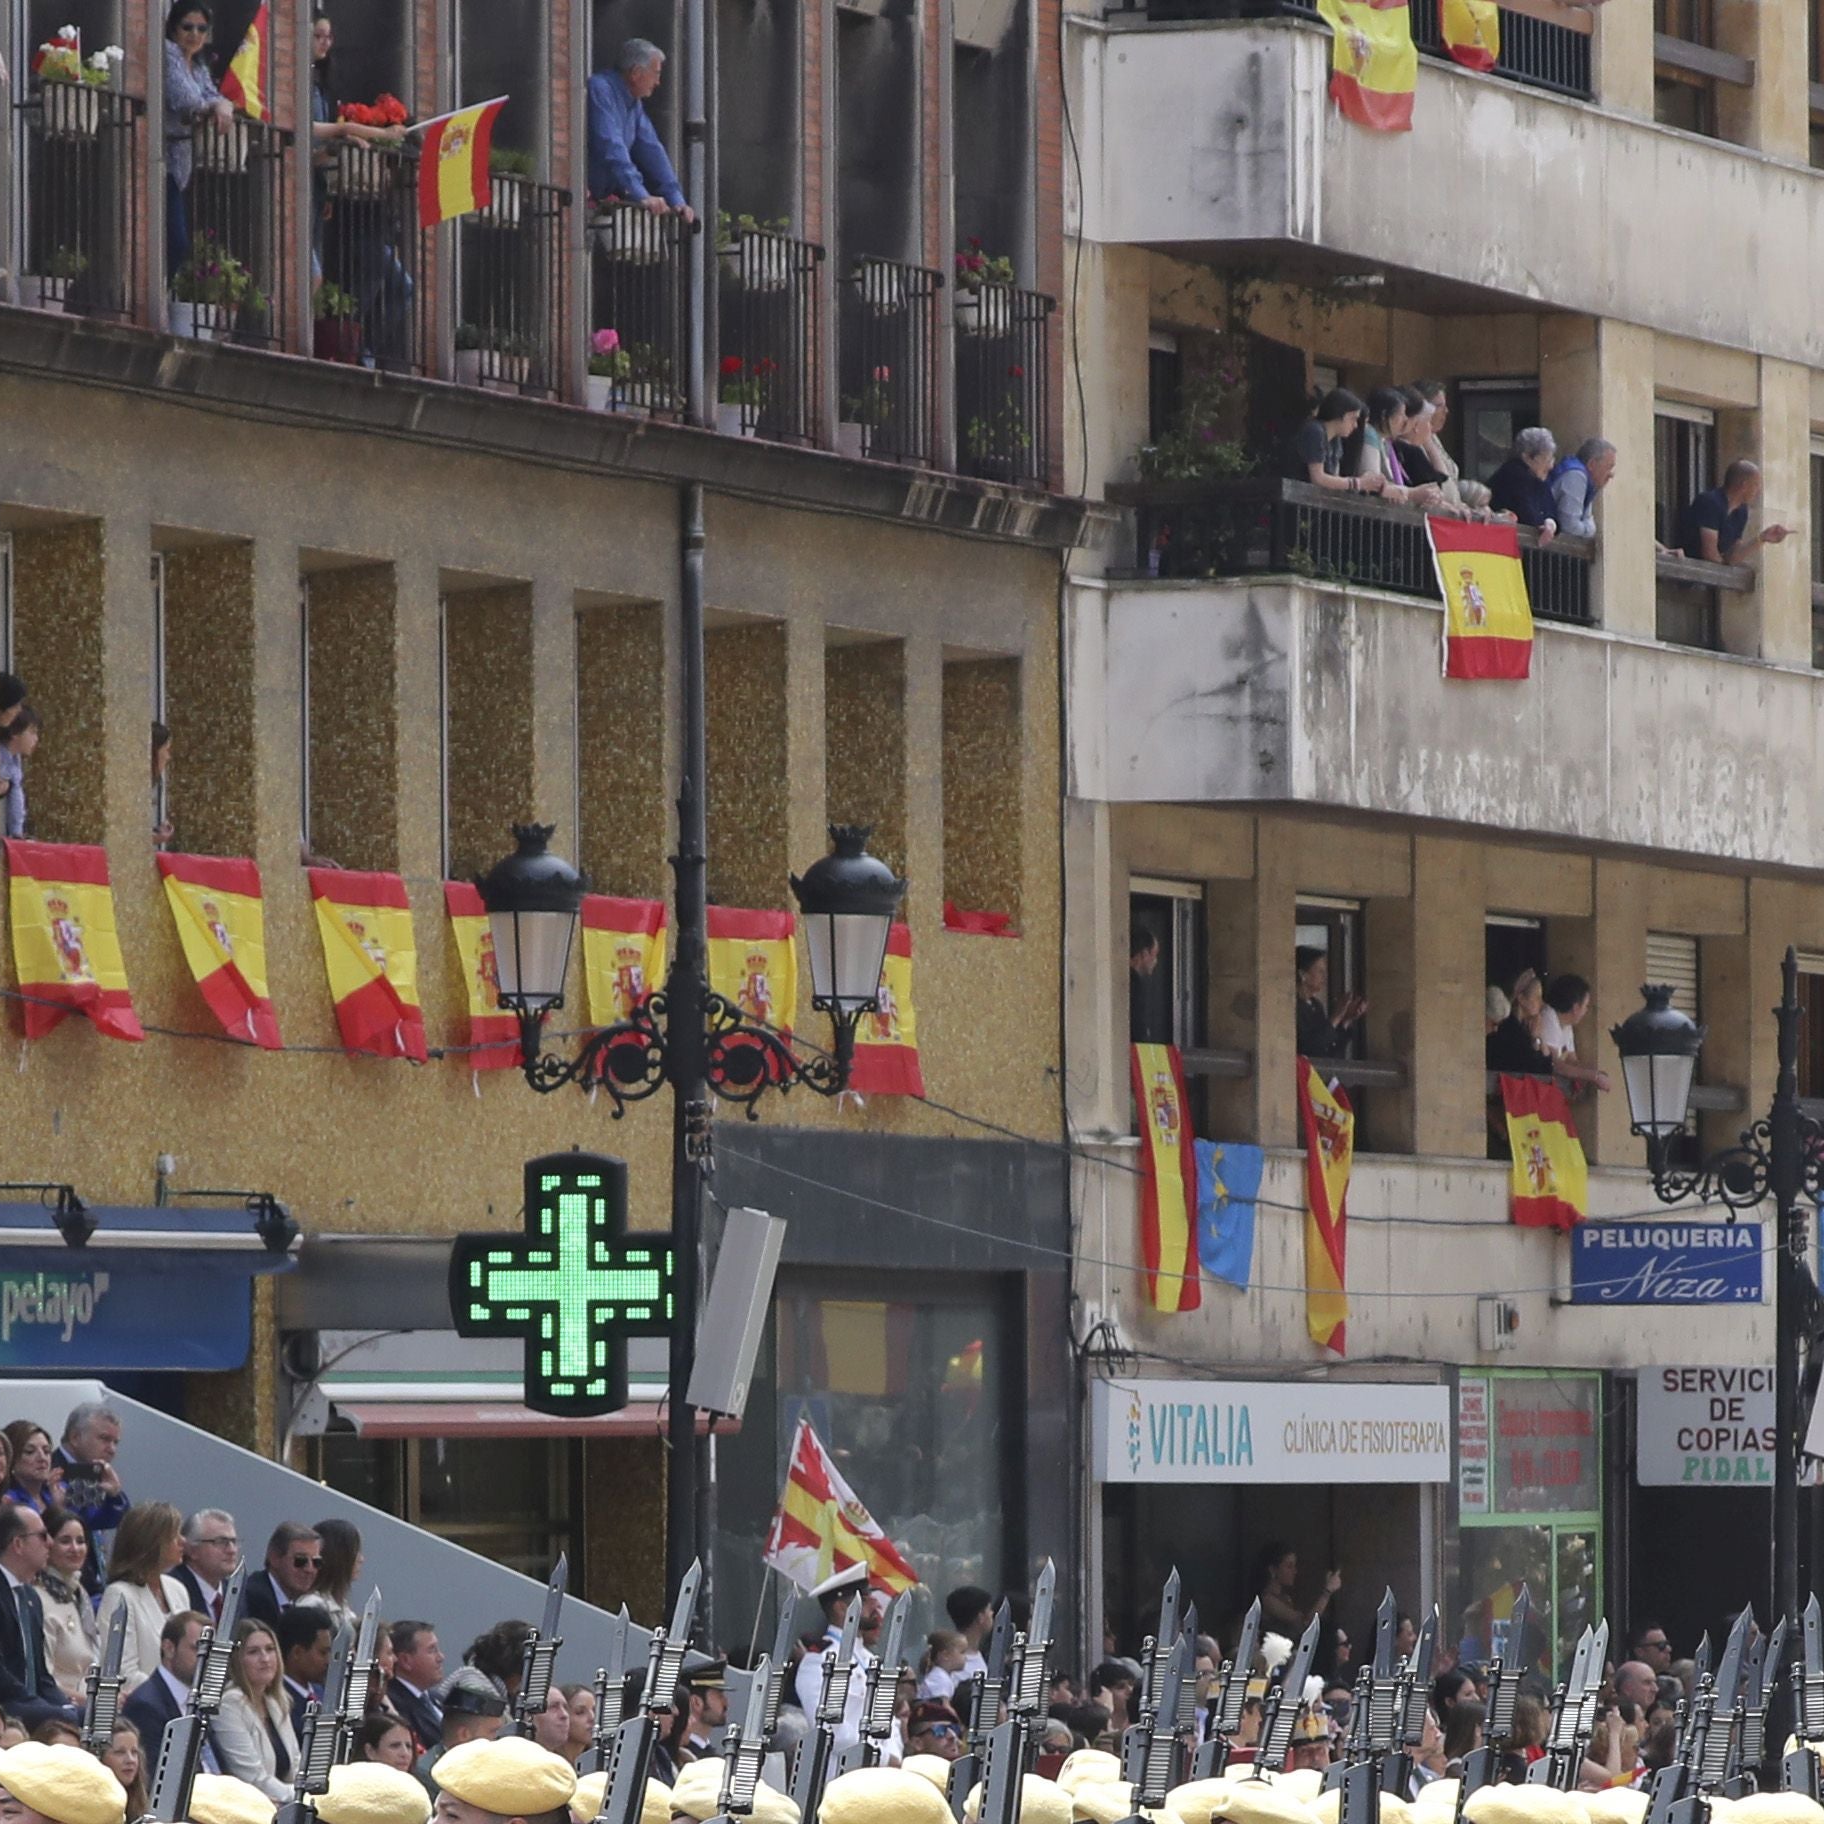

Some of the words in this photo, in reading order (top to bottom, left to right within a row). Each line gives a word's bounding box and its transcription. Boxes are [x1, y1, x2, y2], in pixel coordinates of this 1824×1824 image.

[1583, 1228, 1754, 1250] PELUQUERIA
[1600, 1255, 1729, 1299] Niza
[1751, 1287, 1759, 1298] F
[1, 1272, 93, 1342] pelayo
[1663, 1369, 1773, 1393] SERVICI
[1709, 1397, 1745, 1421] DE
[1148, 1403, 1253, 1466] VITALIA
[1283, 1412, 1336, 1454] CLÍNICA
[1339, 1421, 1358, 1454] DE
[1360, 1421, 1446, 1454] FISIOTERAPIA
[1677, 1427, 1777, 1451] COPIAS
[1682, 1456, 1771, 1481] PIDAL
